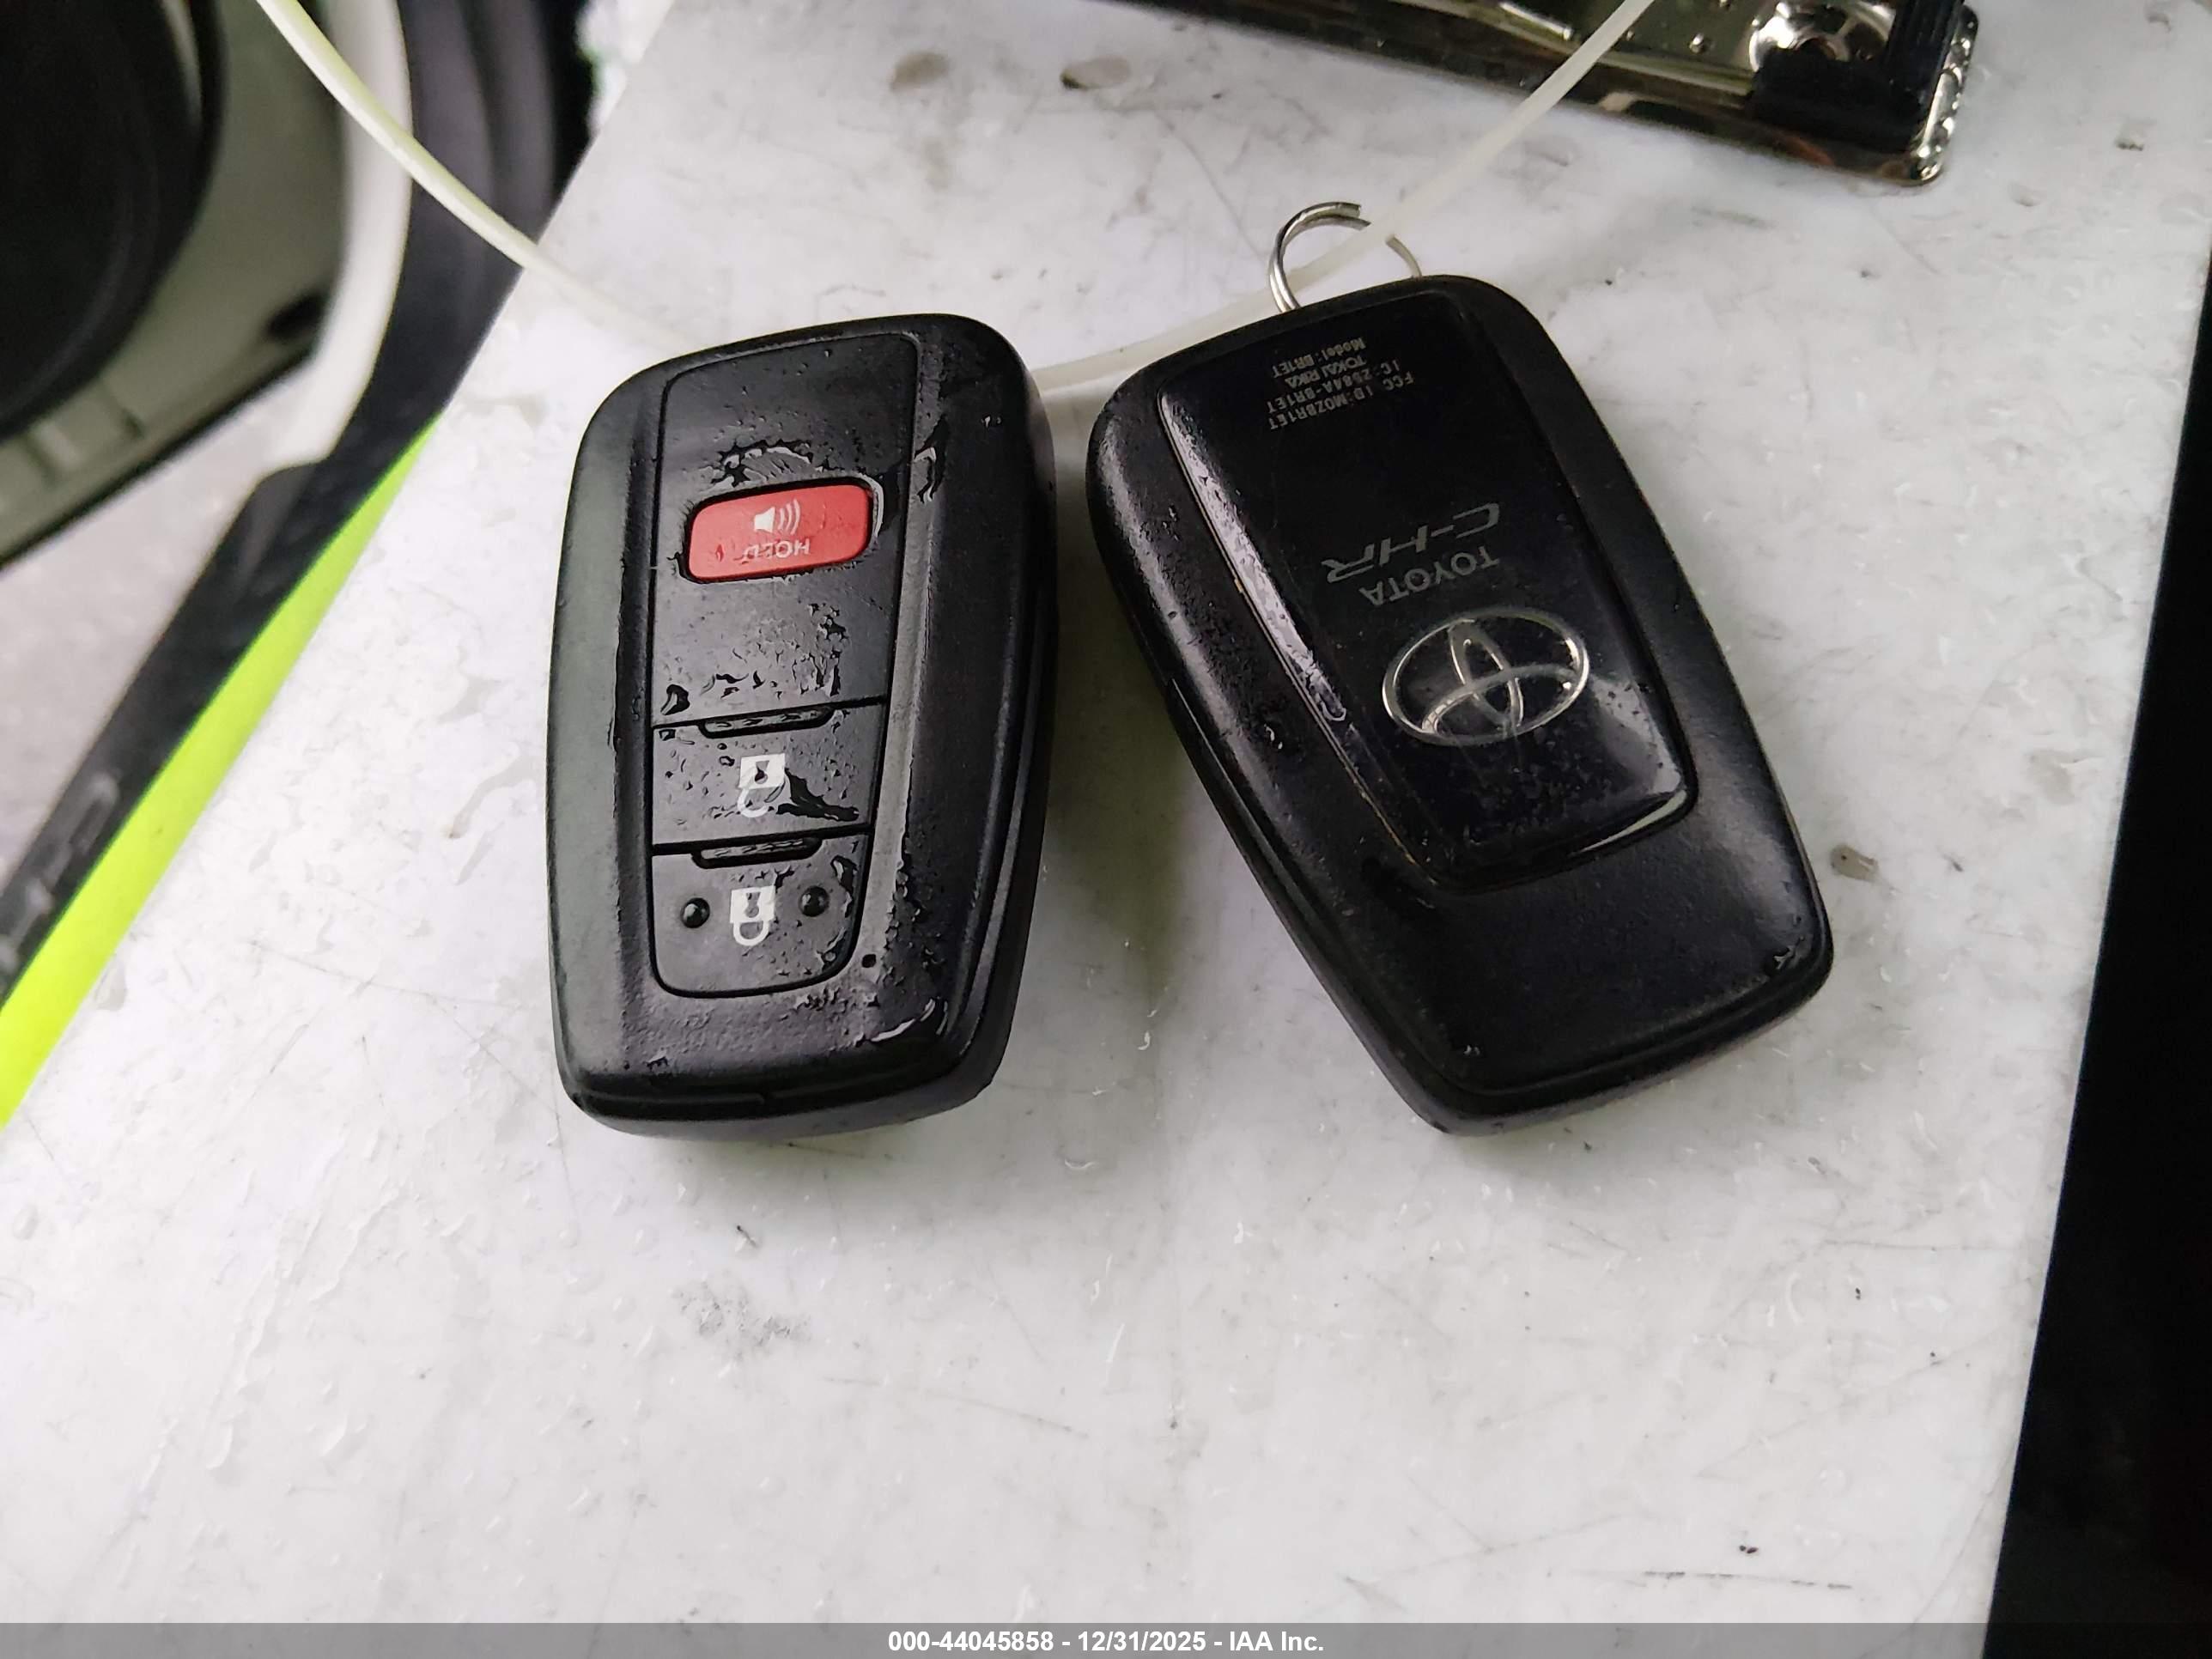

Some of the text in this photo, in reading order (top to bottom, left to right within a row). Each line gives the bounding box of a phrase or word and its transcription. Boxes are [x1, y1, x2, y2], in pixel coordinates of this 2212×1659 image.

[1284, 355, 1368, 389] TOKAI RIKA
[1382, 371, 1415, 391] FCC
[743, 538, 811, 559] HOLD
[1321, 502, 1500, 584] C-HR
[1358, 545, 1501, 606] TOYOTA
